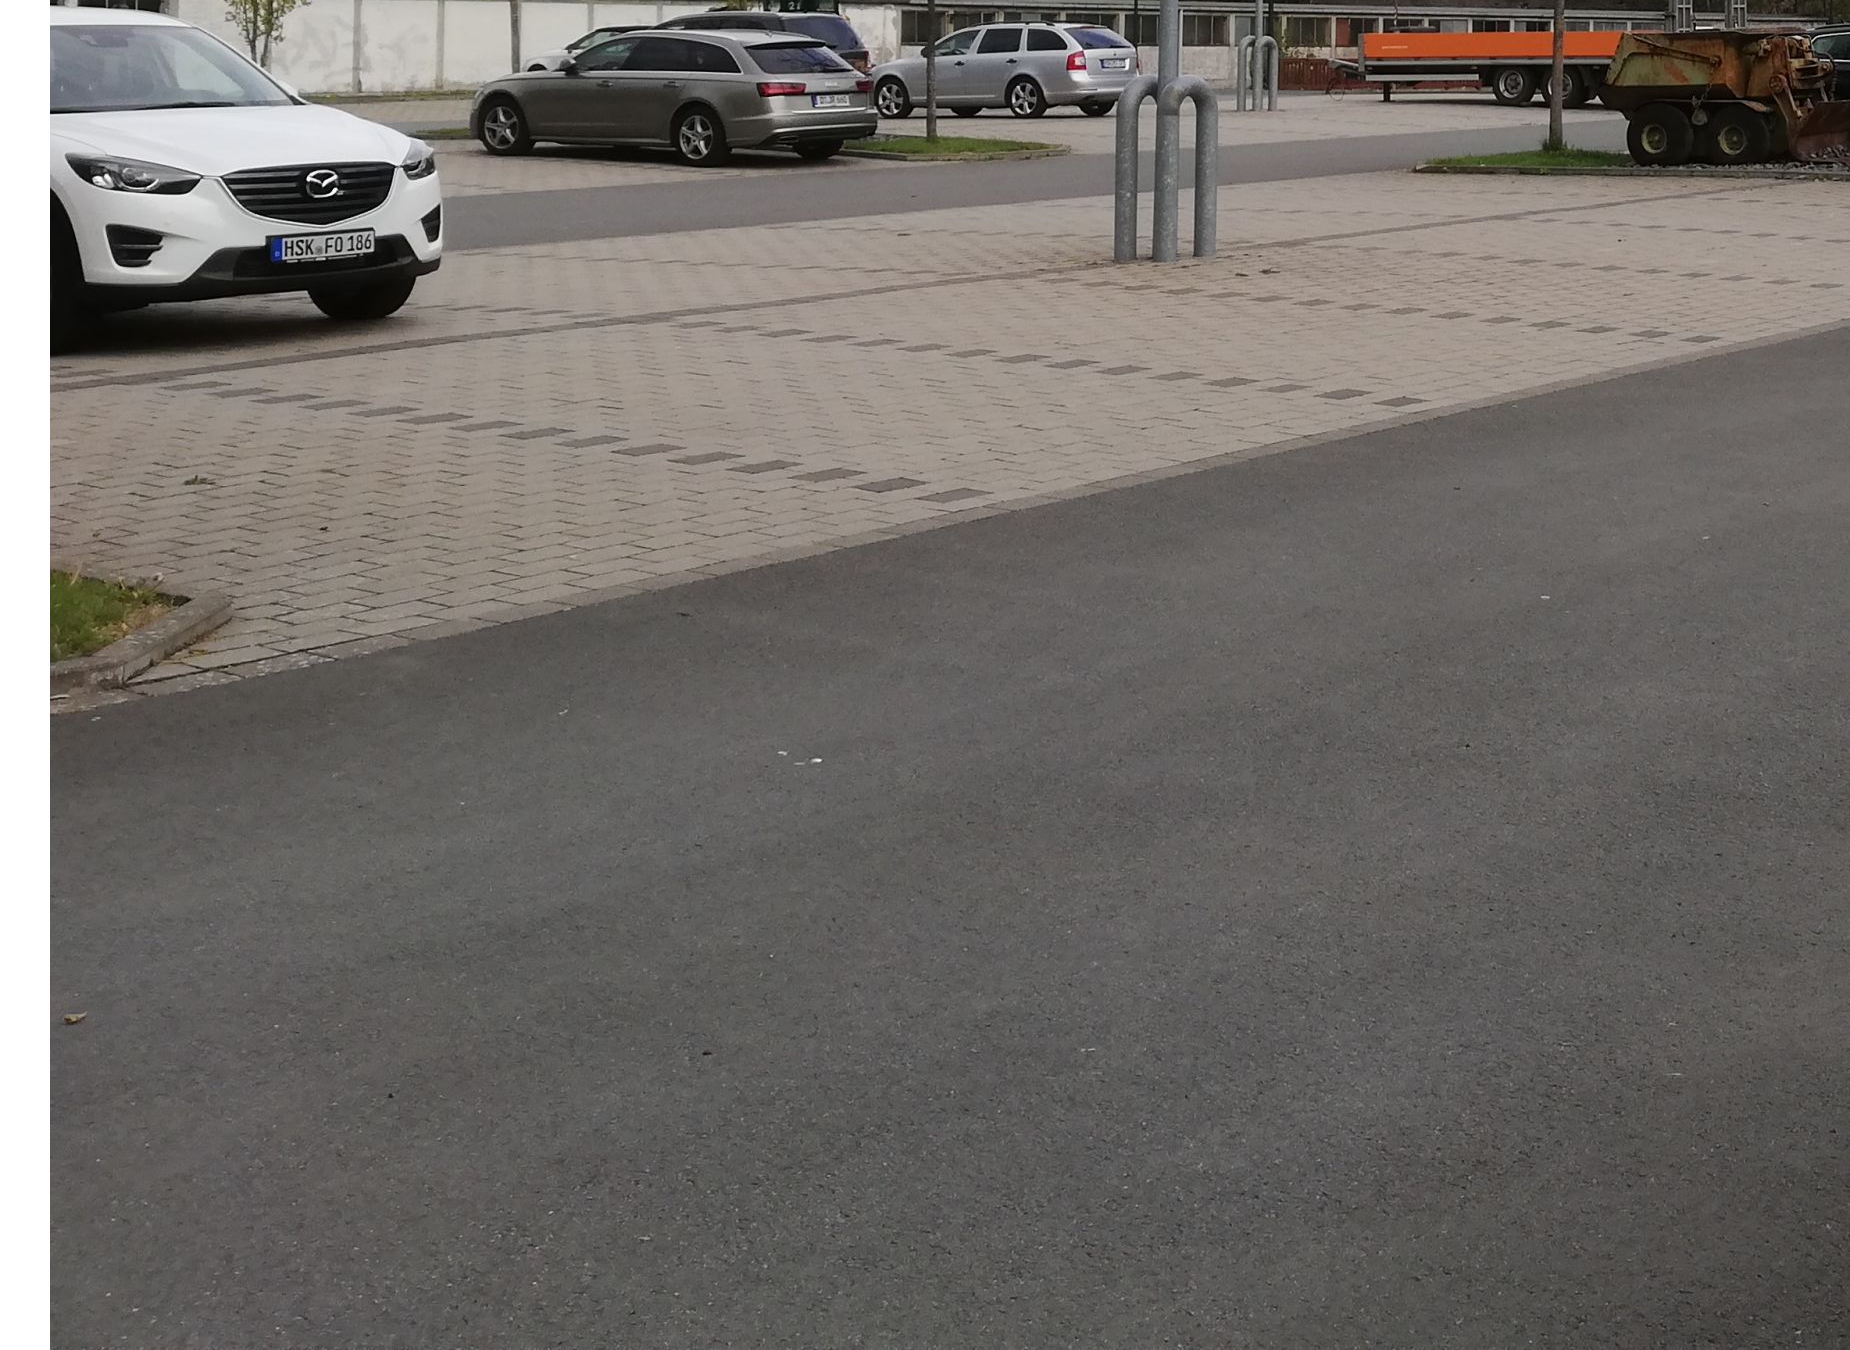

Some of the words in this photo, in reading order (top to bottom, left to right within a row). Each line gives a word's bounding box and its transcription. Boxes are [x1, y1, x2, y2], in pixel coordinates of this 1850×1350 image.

[284, 239, 314, 257] HSK
[325, 236, 343, 254] FO
[347, 233, 372, 252] 186
